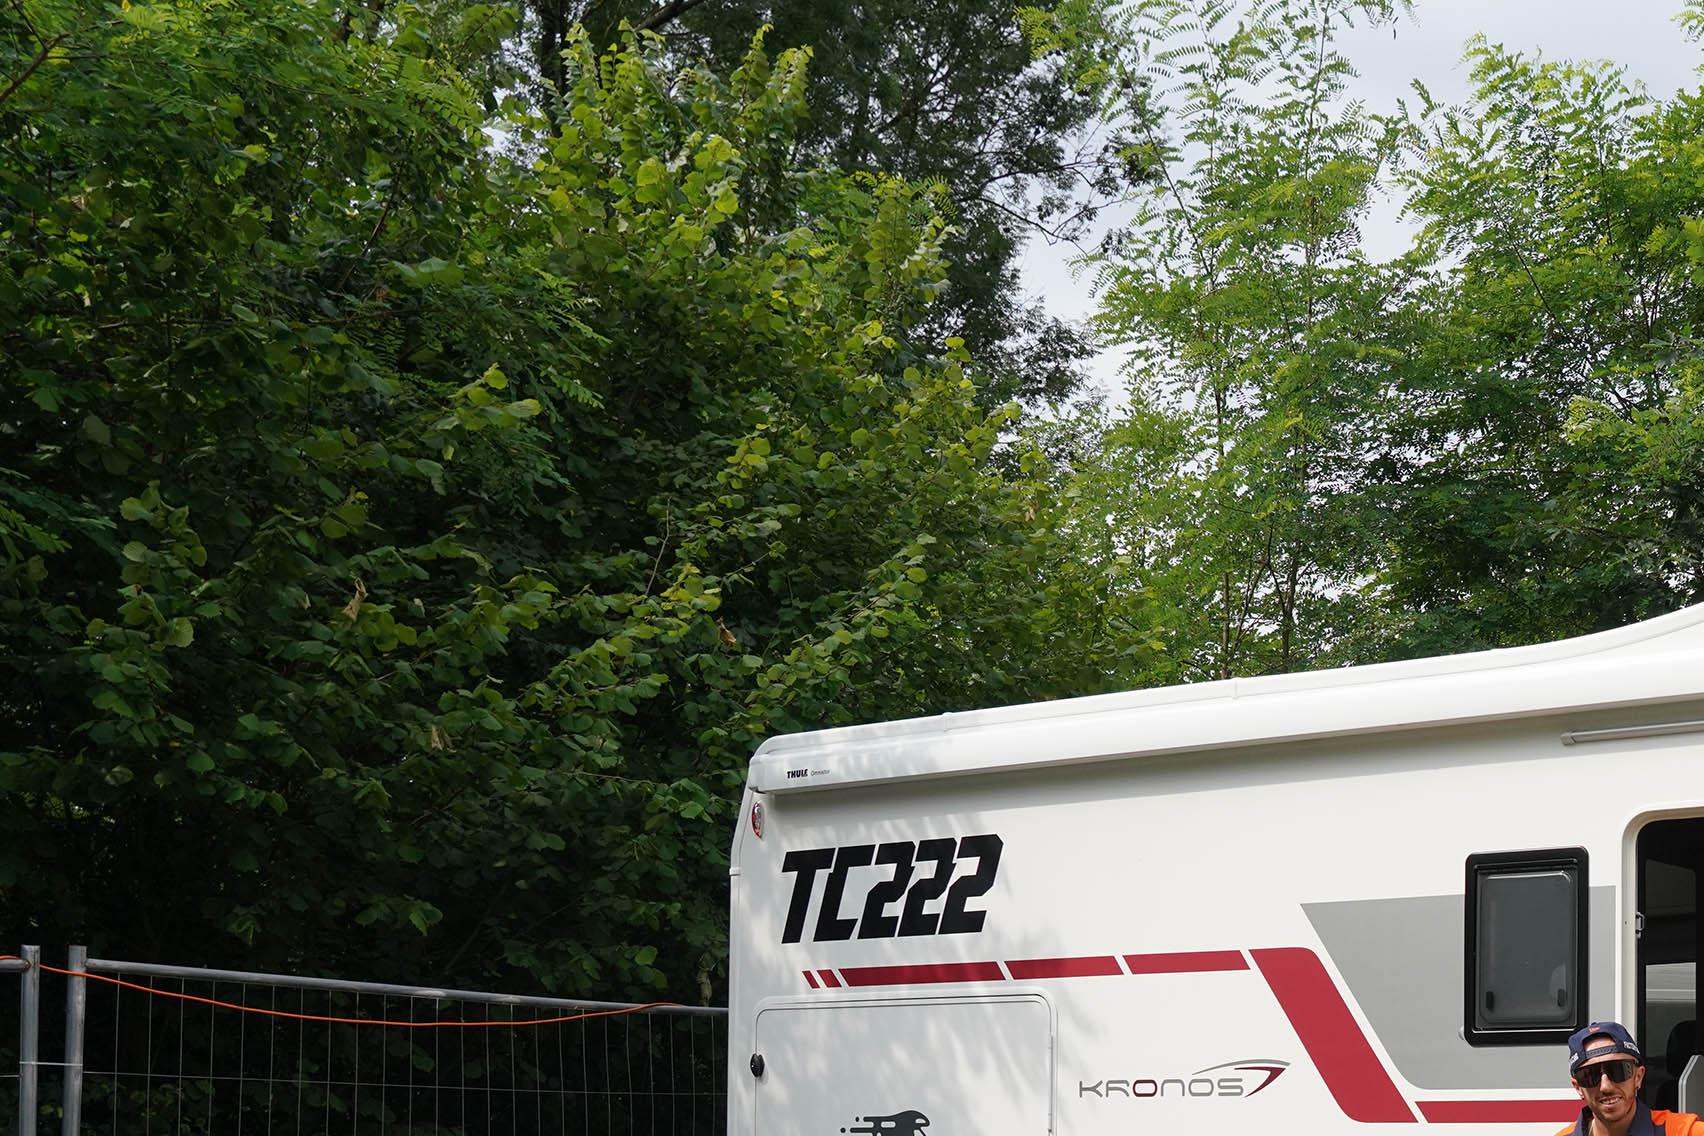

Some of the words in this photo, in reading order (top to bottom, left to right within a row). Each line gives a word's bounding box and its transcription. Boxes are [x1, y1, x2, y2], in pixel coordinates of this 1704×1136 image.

[787, 769, 808, 779] THULE
[781, 833, 1004, 945] TC222
[1079, 1078, 1244, 1098] KRONOS
